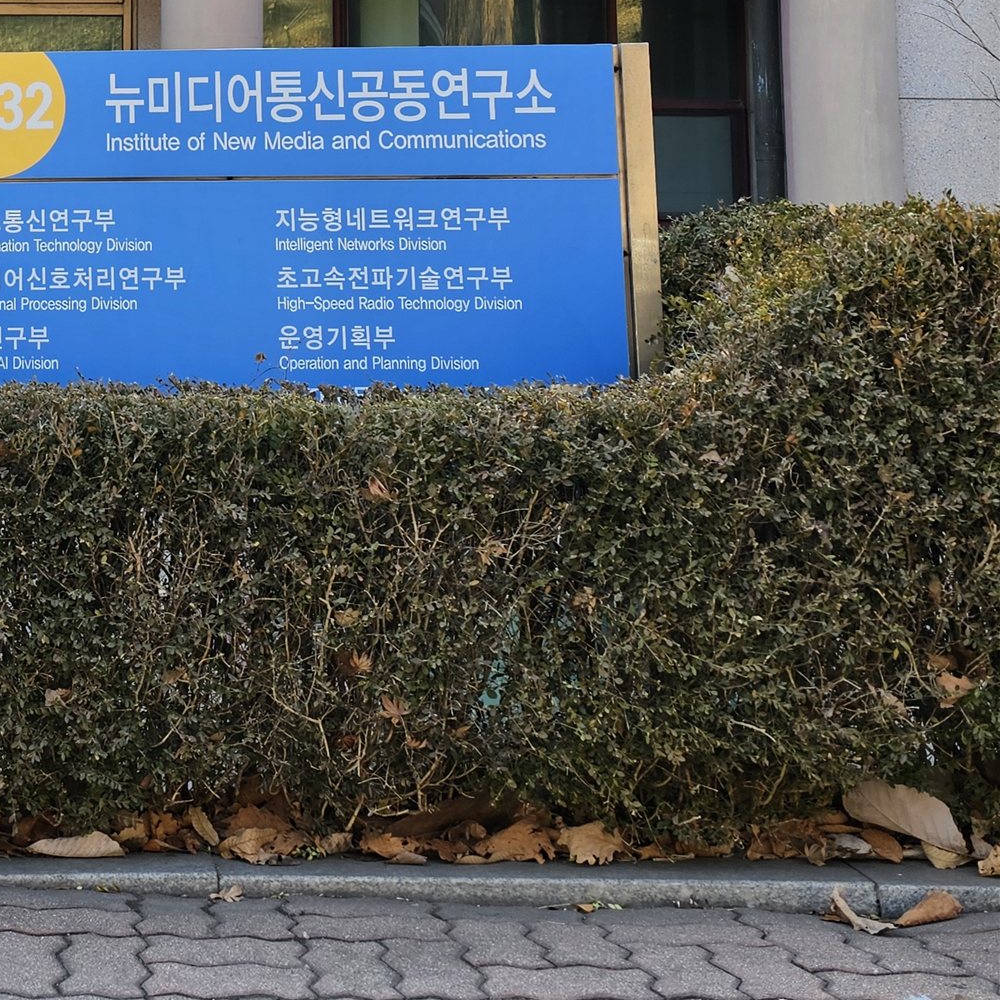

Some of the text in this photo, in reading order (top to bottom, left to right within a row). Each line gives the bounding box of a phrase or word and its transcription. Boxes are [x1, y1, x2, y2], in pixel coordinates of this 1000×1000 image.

[105, 68, 556, 123] 뉴미디어통신공동연구소
[106, 129, 547, 151] Institute of New Media and Communications
[275, 206, 511, 232] 지능형네트워크연구부
[33, 238, 103, 254] Technology
[107, 238, 153, 252] Division
[275, 237, 447, 254] Intelligent Networks Division
[276, 266, 513, 291] 초고속전파기술연구부
[21, 297, 87, 313] Processing
[91, 297, 138, 311] Division
[277, 296, 523, 313] High-Speed Radio Technology Division
[278, 325, 396, 351] 운영기획부
[12, 356, 59, 370] Division
[279, 356, 480, 373] Operation and Planning Division
